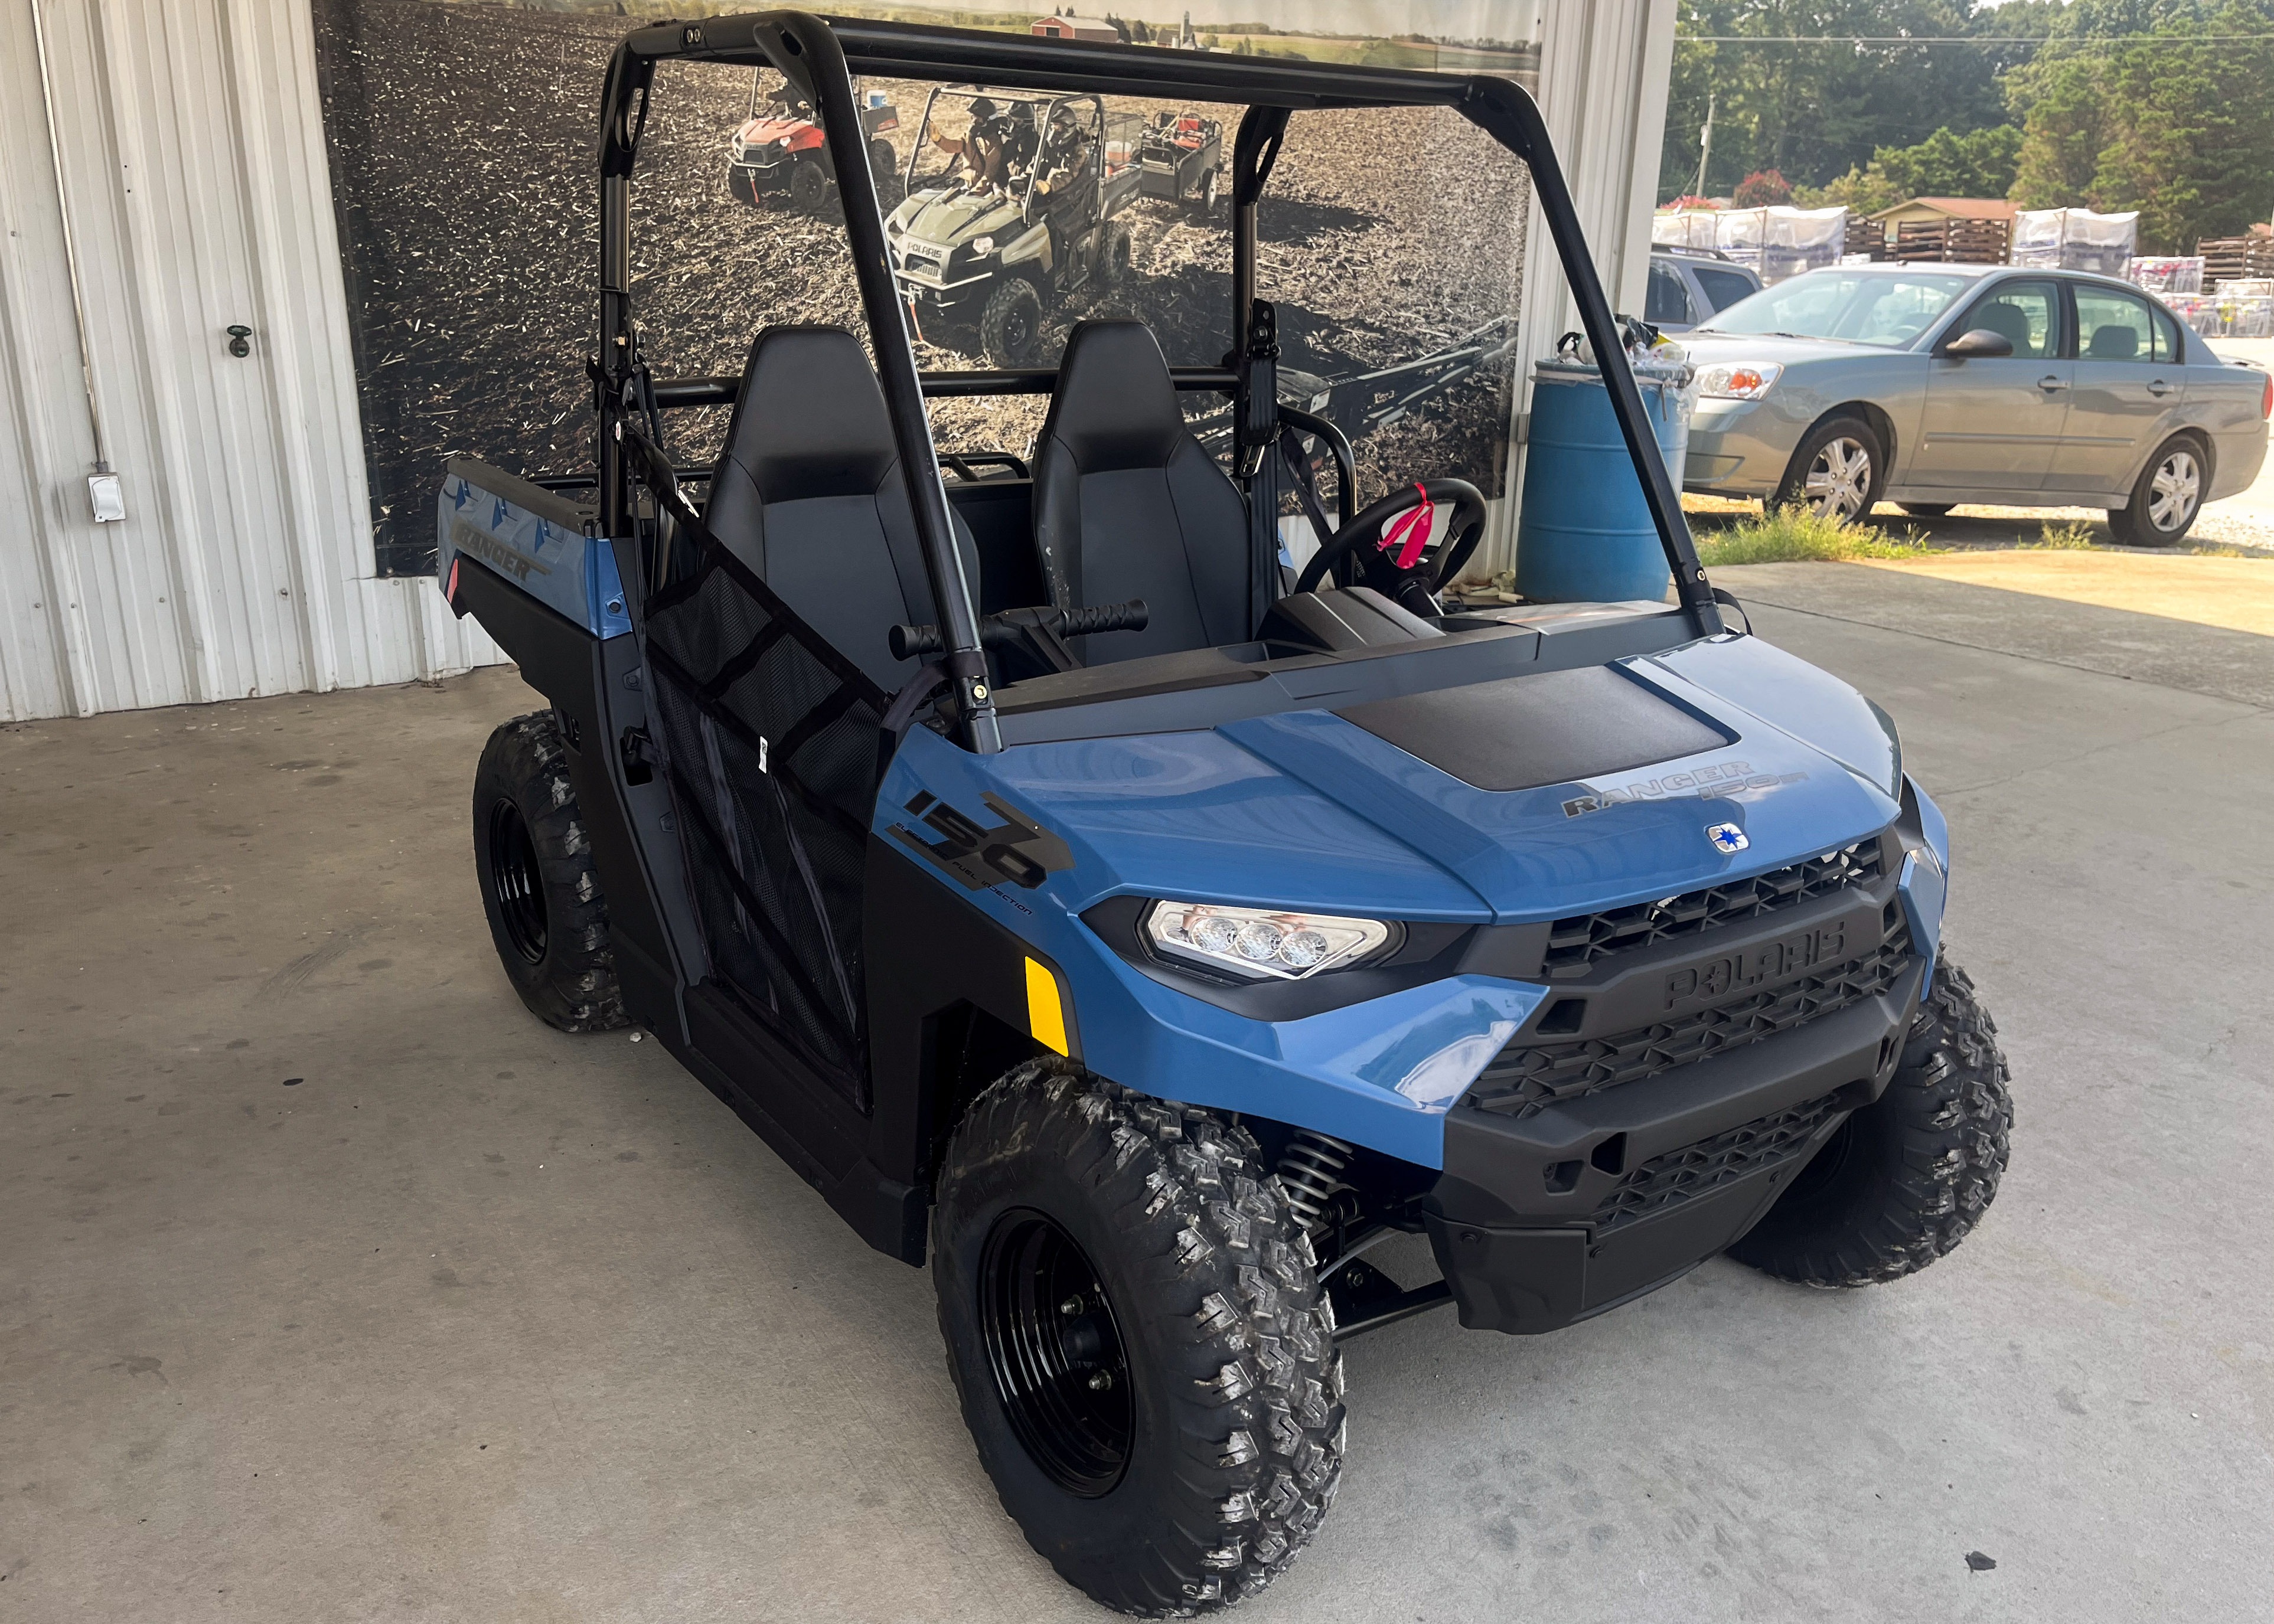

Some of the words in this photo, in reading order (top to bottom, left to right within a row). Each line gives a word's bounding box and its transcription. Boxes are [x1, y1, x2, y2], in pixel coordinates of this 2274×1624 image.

[907, 242, 942, 258] POLARIS
[1560, 760, 1756, 818] RANGER
[1696, 775, 1780, 801] 150
[903, 789, 1048, 890] 150
[952, 861, 978, 880] FUEL
[981, 880, 1033, 916] INJECTION
[1663, 921, 1845, 1012] POLARIS
